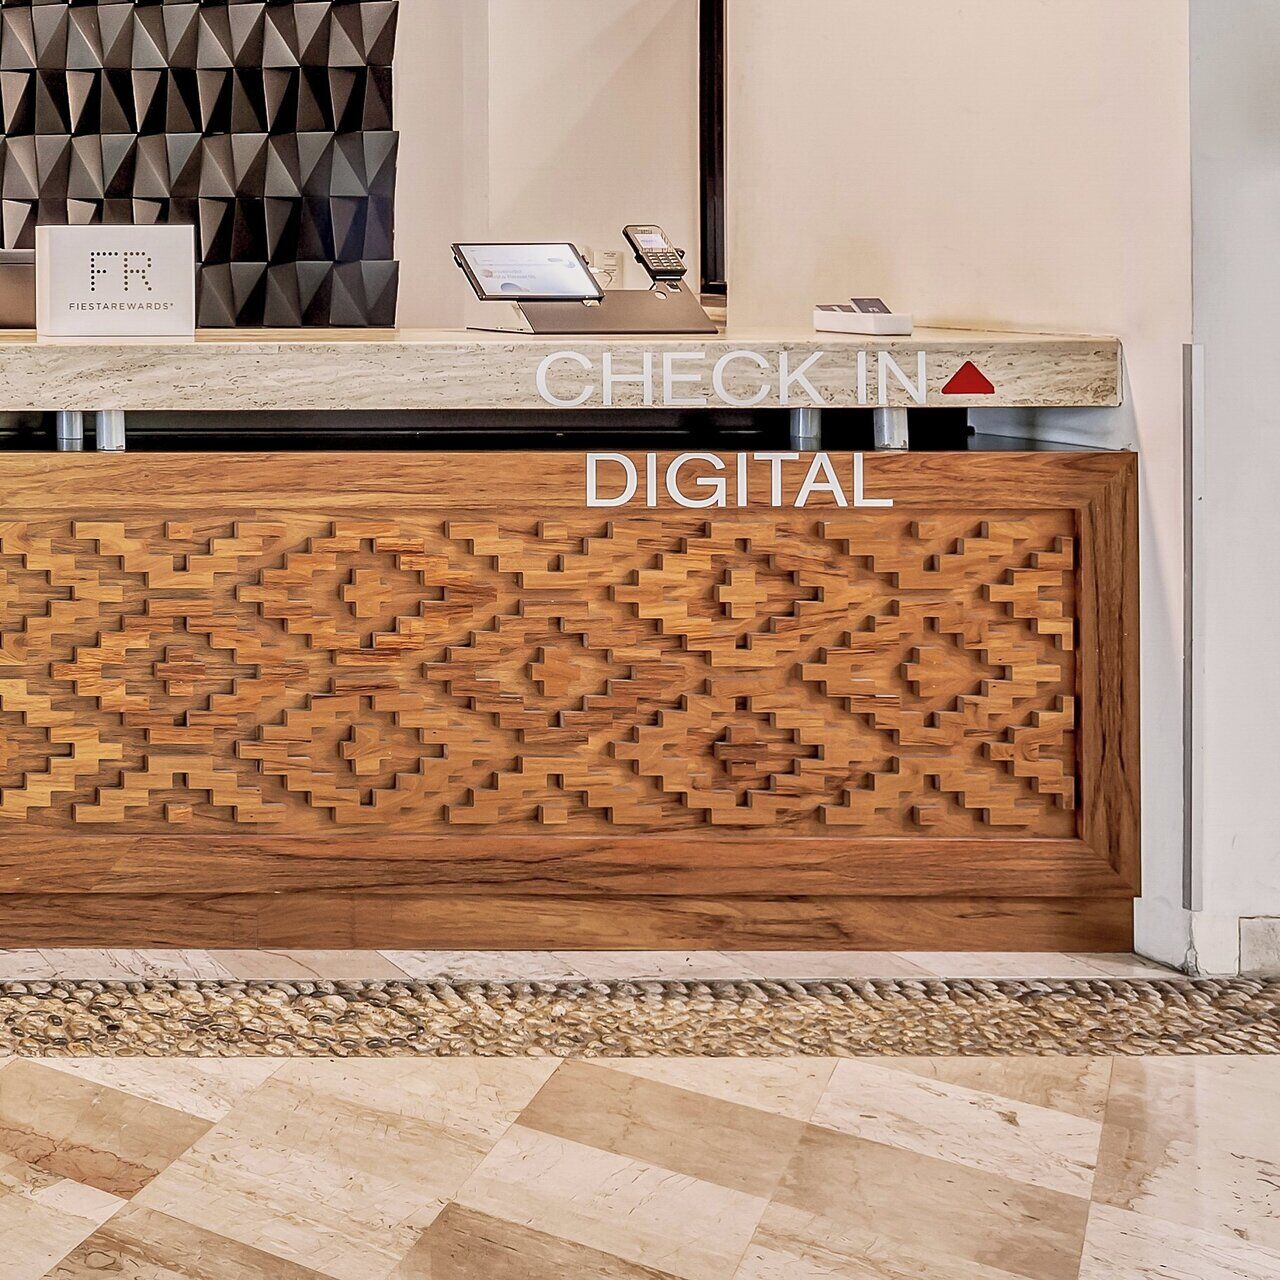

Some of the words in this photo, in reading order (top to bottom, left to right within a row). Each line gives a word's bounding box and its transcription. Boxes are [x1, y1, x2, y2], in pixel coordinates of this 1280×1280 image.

[89, 251, 153, 292] FR
[535, 349, 825, 407] CHECK
[857, 350, 928, 405] IN
[585, 451, 894, 508] DIGITAL
